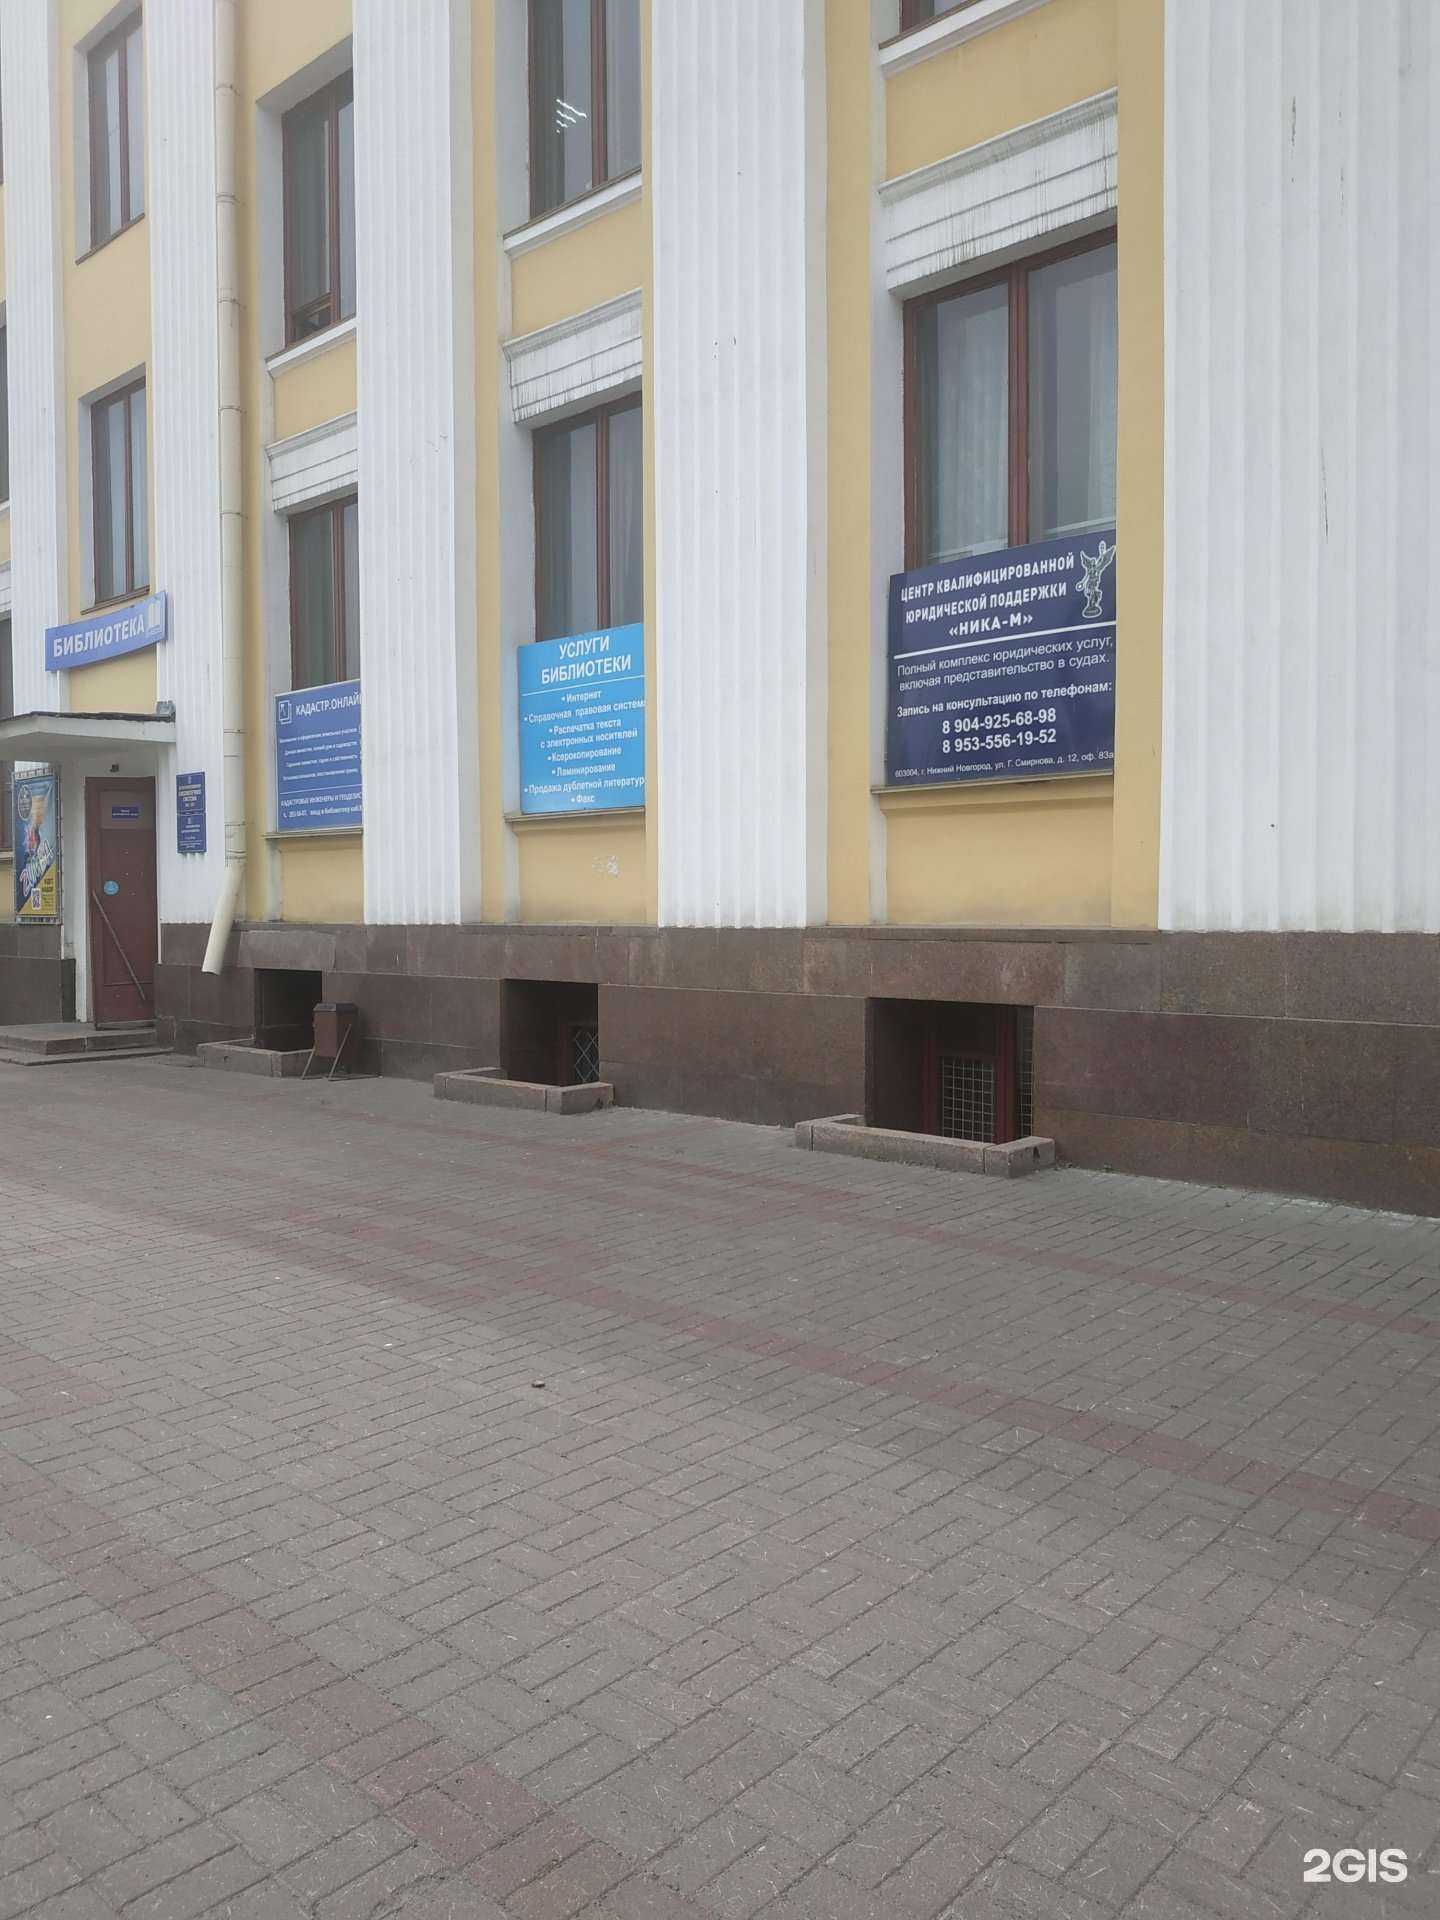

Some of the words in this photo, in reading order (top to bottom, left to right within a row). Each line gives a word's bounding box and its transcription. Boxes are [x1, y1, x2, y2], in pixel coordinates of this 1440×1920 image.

[901, 582, 934, 602] ЦЕНТР
[937, 552, 1074, 594] КВАЛИФИЦИРОВАННОЙ
[906, 595, 987, 624] ЮРИДИЧЕСКОЙ
[990, 582, 1067, 608] ПОДДЕРЖКИ
[53, 614, 145, 657] БИБЛИОТЕКА
[949, 612, 1033, 637] «НИКА-М»
[559, 635, 610, 660] УСЛУГИ
[897, 659, 936, 676] Полный
[939, 653, 990, 670] комплекс
[993, 643, 1073, 666] юридических
[1076, 636, 1113, 654] услуг,
[541, 654, 631, 684] БИБЛИОТЕКИ
[899, 675, 941, 691] включая
[943, 659, 1055, 685] представительство
[1058, 658, 1066, 668] в
[1069, 652, 1110, 670] судах.
[566, 690, 603, 703] Интернет
[897, 701, 930, 718] Запись
[932, 701, 944, 713] на
[946, 692, 1022, 712] консультацию
[1024, 689, 1039, 700] по
[1041, 681, 1113, 699] телефонам:
[529, 709, 572, 724] Справочная
[575, 702, 612, 718] правовая
[942, 719, 951, 735] 8
[954, 707, 1057, 733] 904-925-68-98
[540, 741, 545, 749] с
[546, 735, 594, 749] электронных
[596, 728, 638, 742] носителей
[554, 722, 595, 736] Распечатка
[597, 719, 622, 729] текста
[942, 738, 951, 754] 8
[954, 728, 1057, 752] 953-556-19-52
[551, 748, 622, 762] Ксерокопирование
[926, 764, 955, 776] Нижний
[1081, 753, 1095, 763] оф.
[557, 763, 616, 777] Ламинирование
[529, 784, 562, 795] Продажа
[604, 776, 647, 788] литератур
[576, 795, 595, 804] Факс
